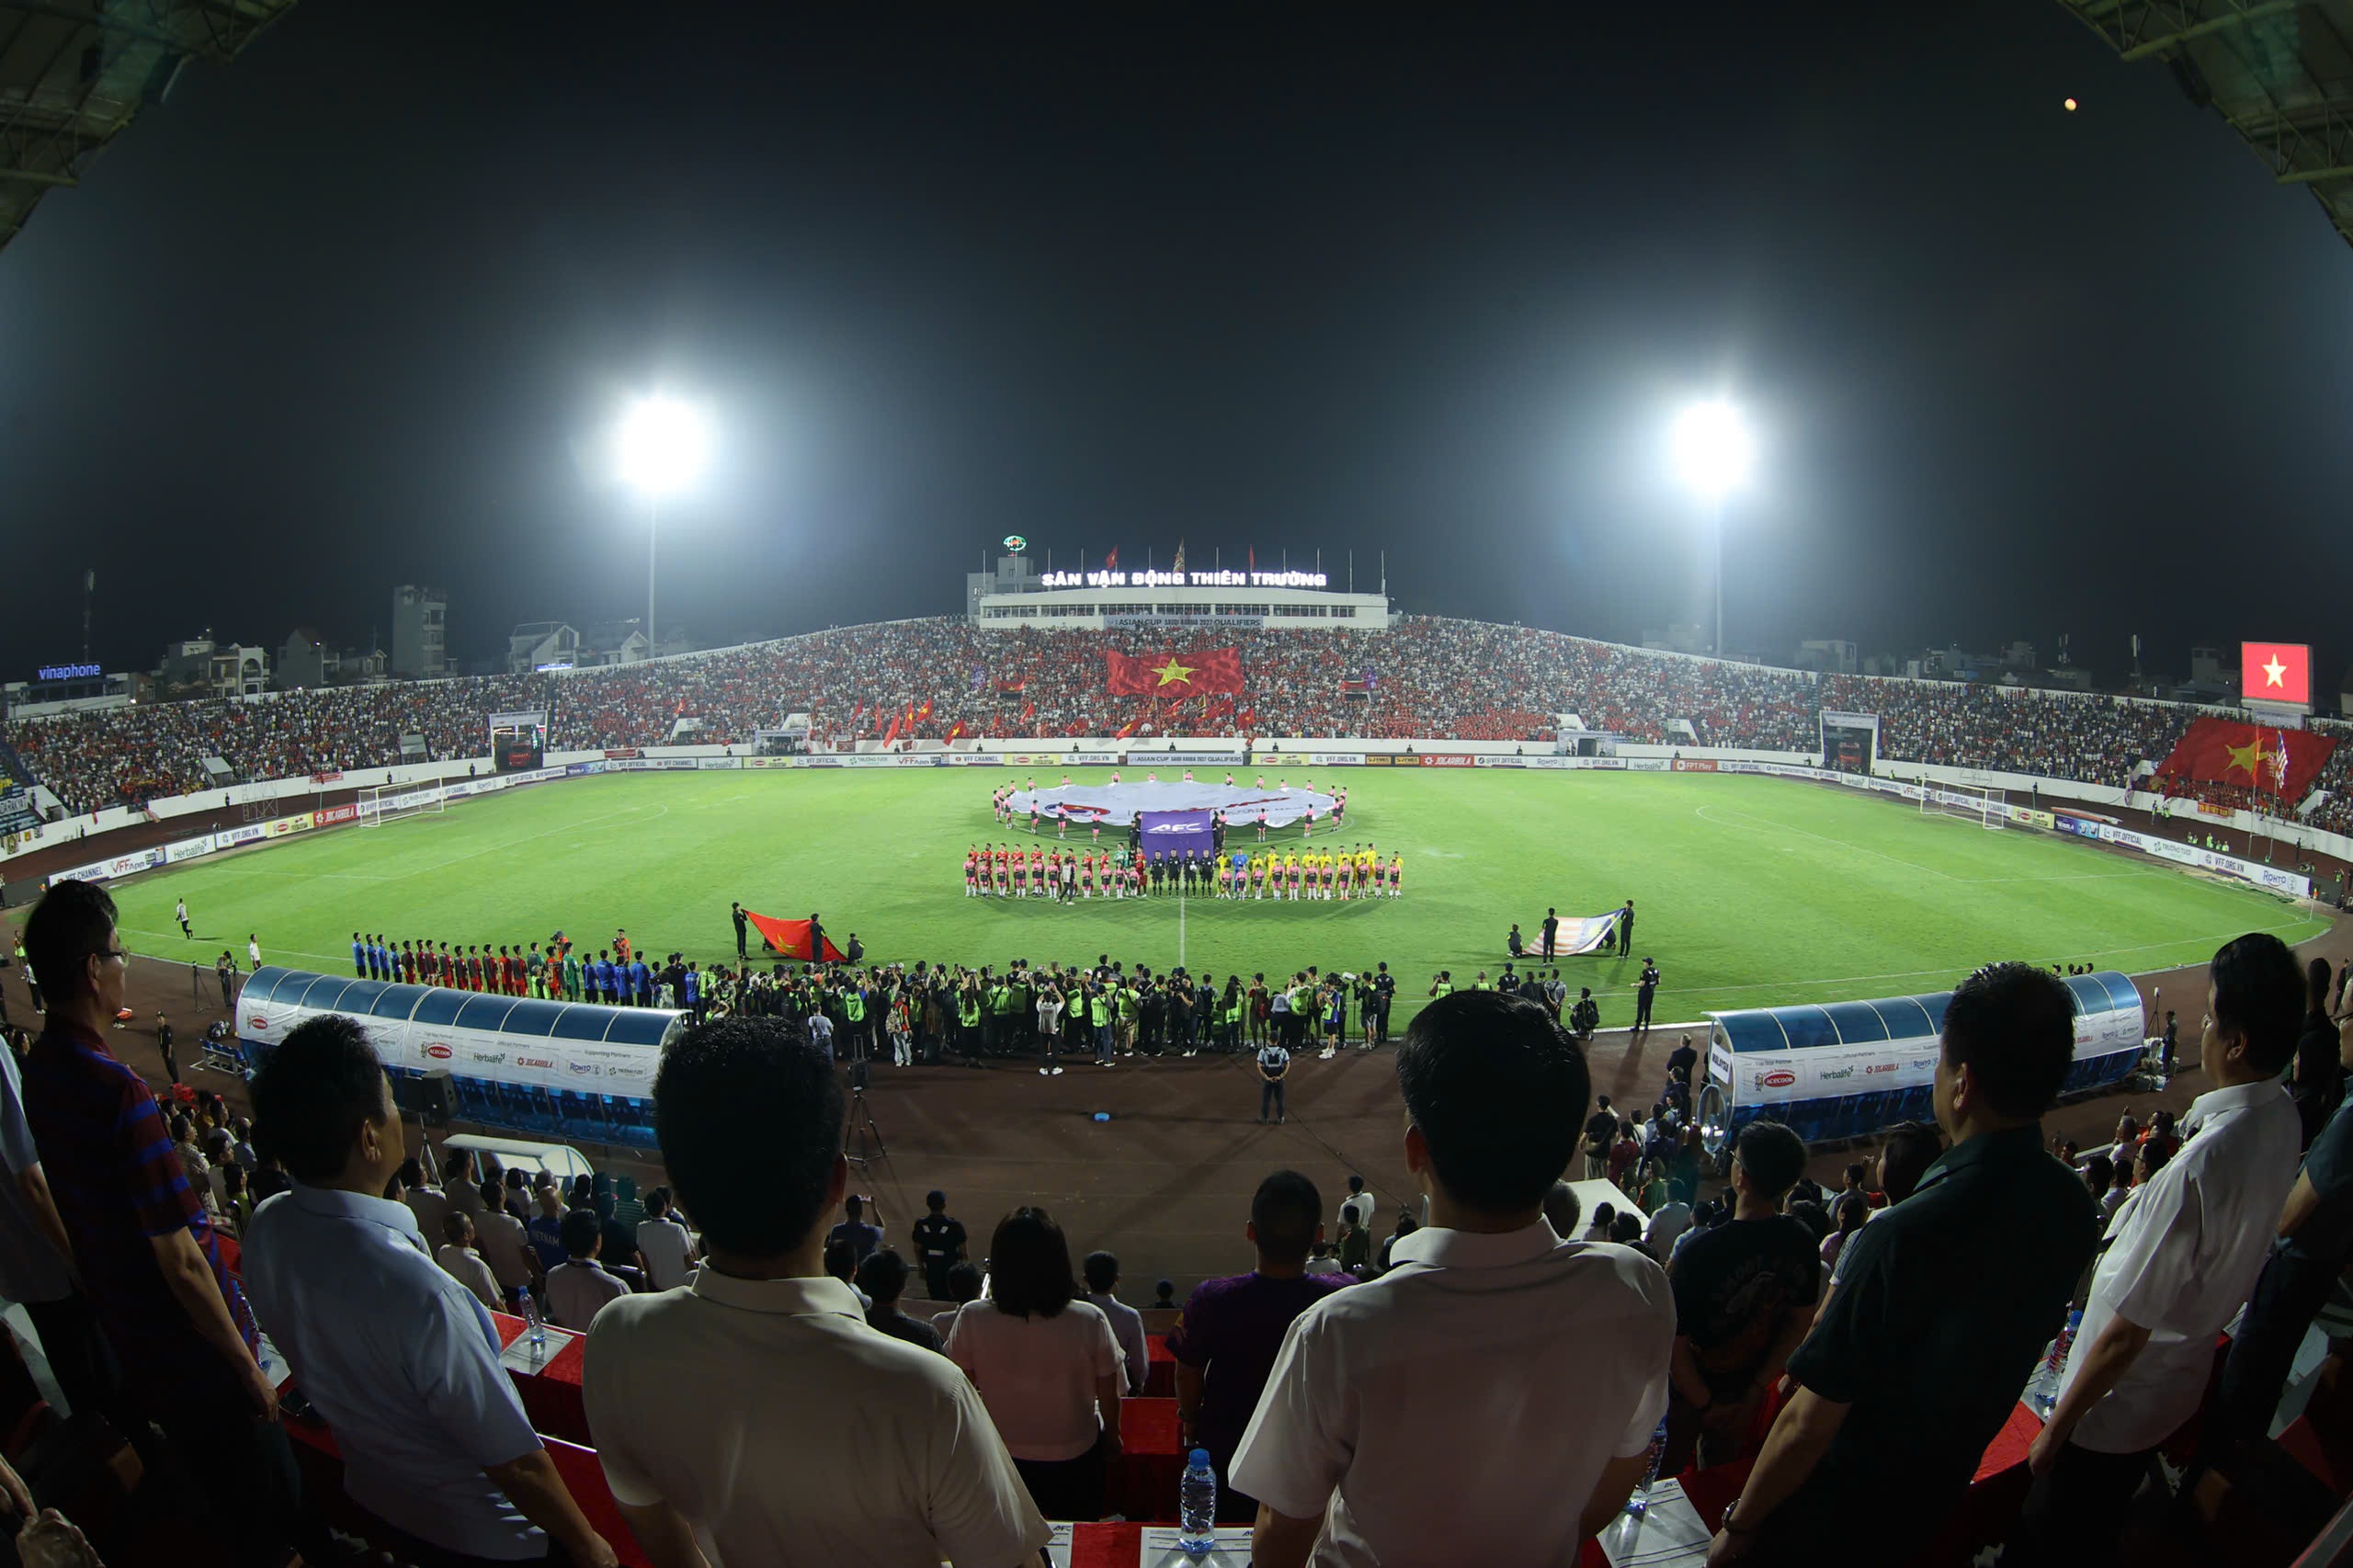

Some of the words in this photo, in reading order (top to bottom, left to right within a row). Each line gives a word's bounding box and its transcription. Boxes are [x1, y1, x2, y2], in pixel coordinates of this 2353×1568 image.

[1041, 570, 1082, 586] SÂN
[1086, 570, 1125, 588] VẬN
[1131, 569, 1185, 588] ĐỘNG
[1190, 569, 1245, 585] THIÊN
[1251, 570, 1327, 586] TRƯỜNG
[1213, 619, 1260, 627] QUALIFIERS
[39, 663, 100, 680] vinaphone
[1699, 762, 1712, 770] Play
[1148, 823, 1202, 832] AFC
[173, 843, 206, 860] Herbalife
[112, 858, 131, 873] VFF
[2215, 856, 2245, 872] VFF.ORG.VN
[77, 866, 103, 881] CHANNEL
[473, 1052, 503, 1064] Herbalife
[1820, 1069, 1851, 1080] Herbalife
